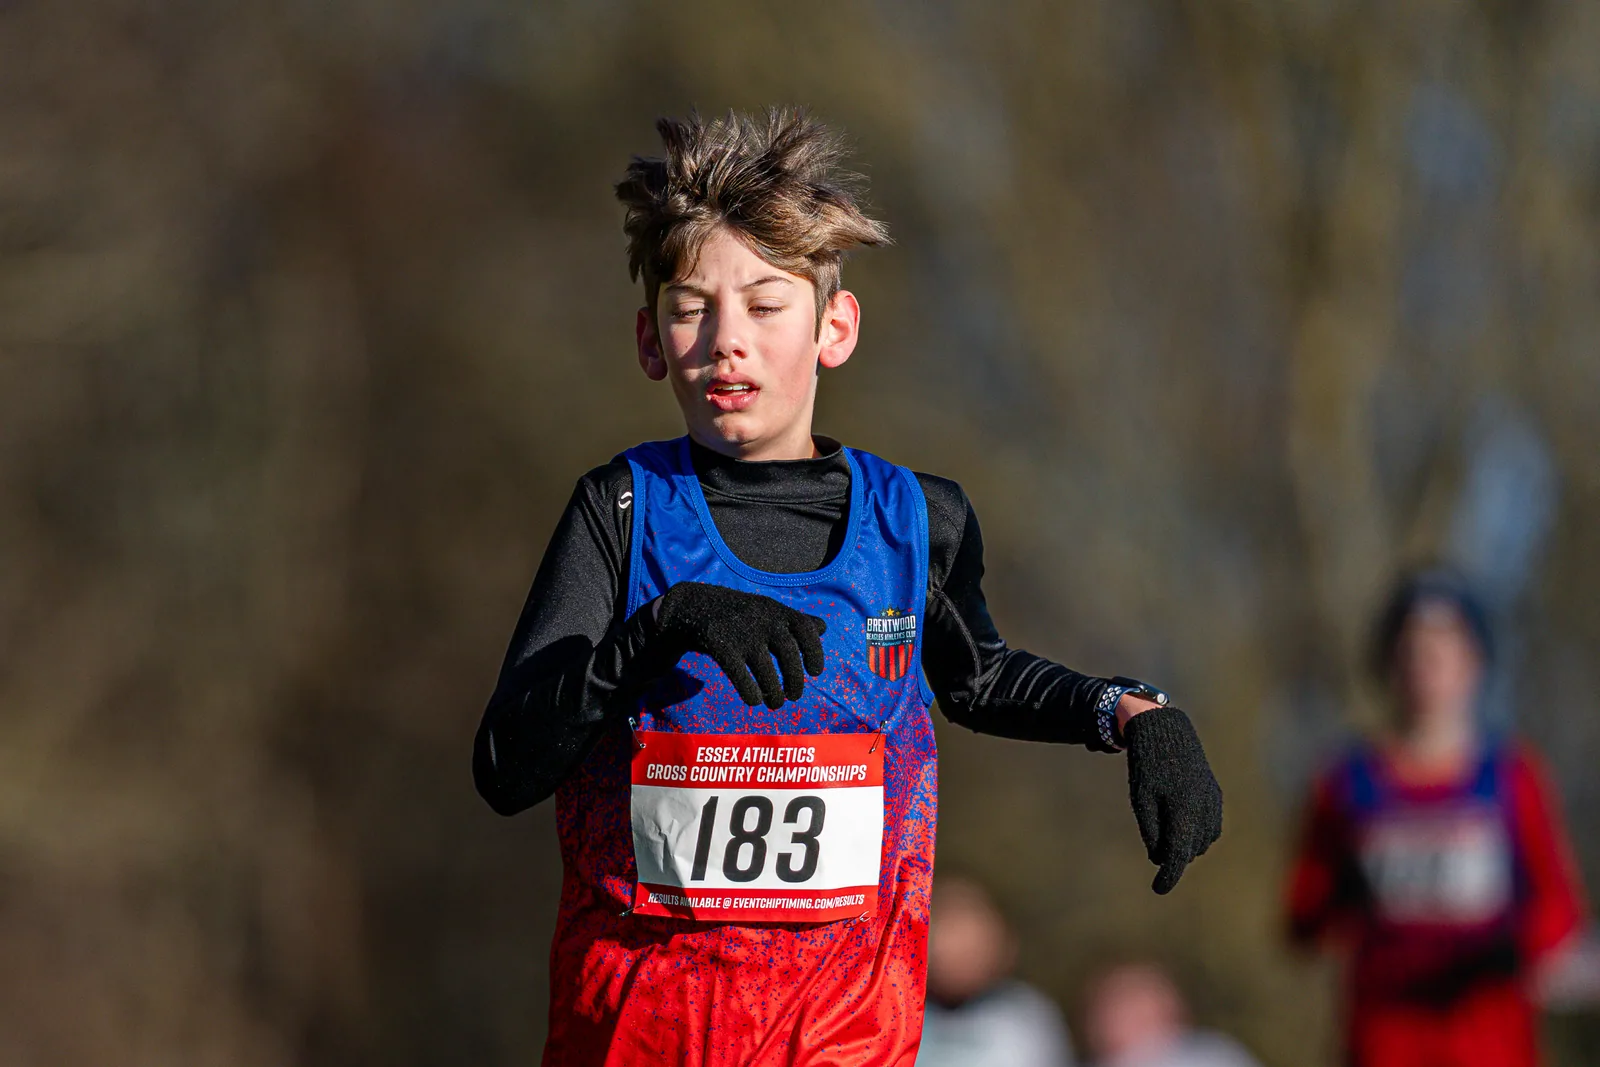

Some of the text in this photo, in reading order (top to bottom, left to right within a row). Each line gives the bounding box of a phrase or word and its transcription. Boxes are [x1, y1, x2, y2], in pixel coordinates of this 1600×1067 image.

[867, 615, 916, 632] BRENTWOOD
[884, 632, 905, 640] ATHLETICS
[696, 747, 815, 763] ESSEX ATHLETICS
[646, 763, 867, 783] CROSS COUNTRY CHAMPIONSHIPS
[690, 795, 826, 883] 183
[648, 892, 864, 908] RESULTS AVAILABLE @ EVENTCHIPTIMING.COM/RESULTS
